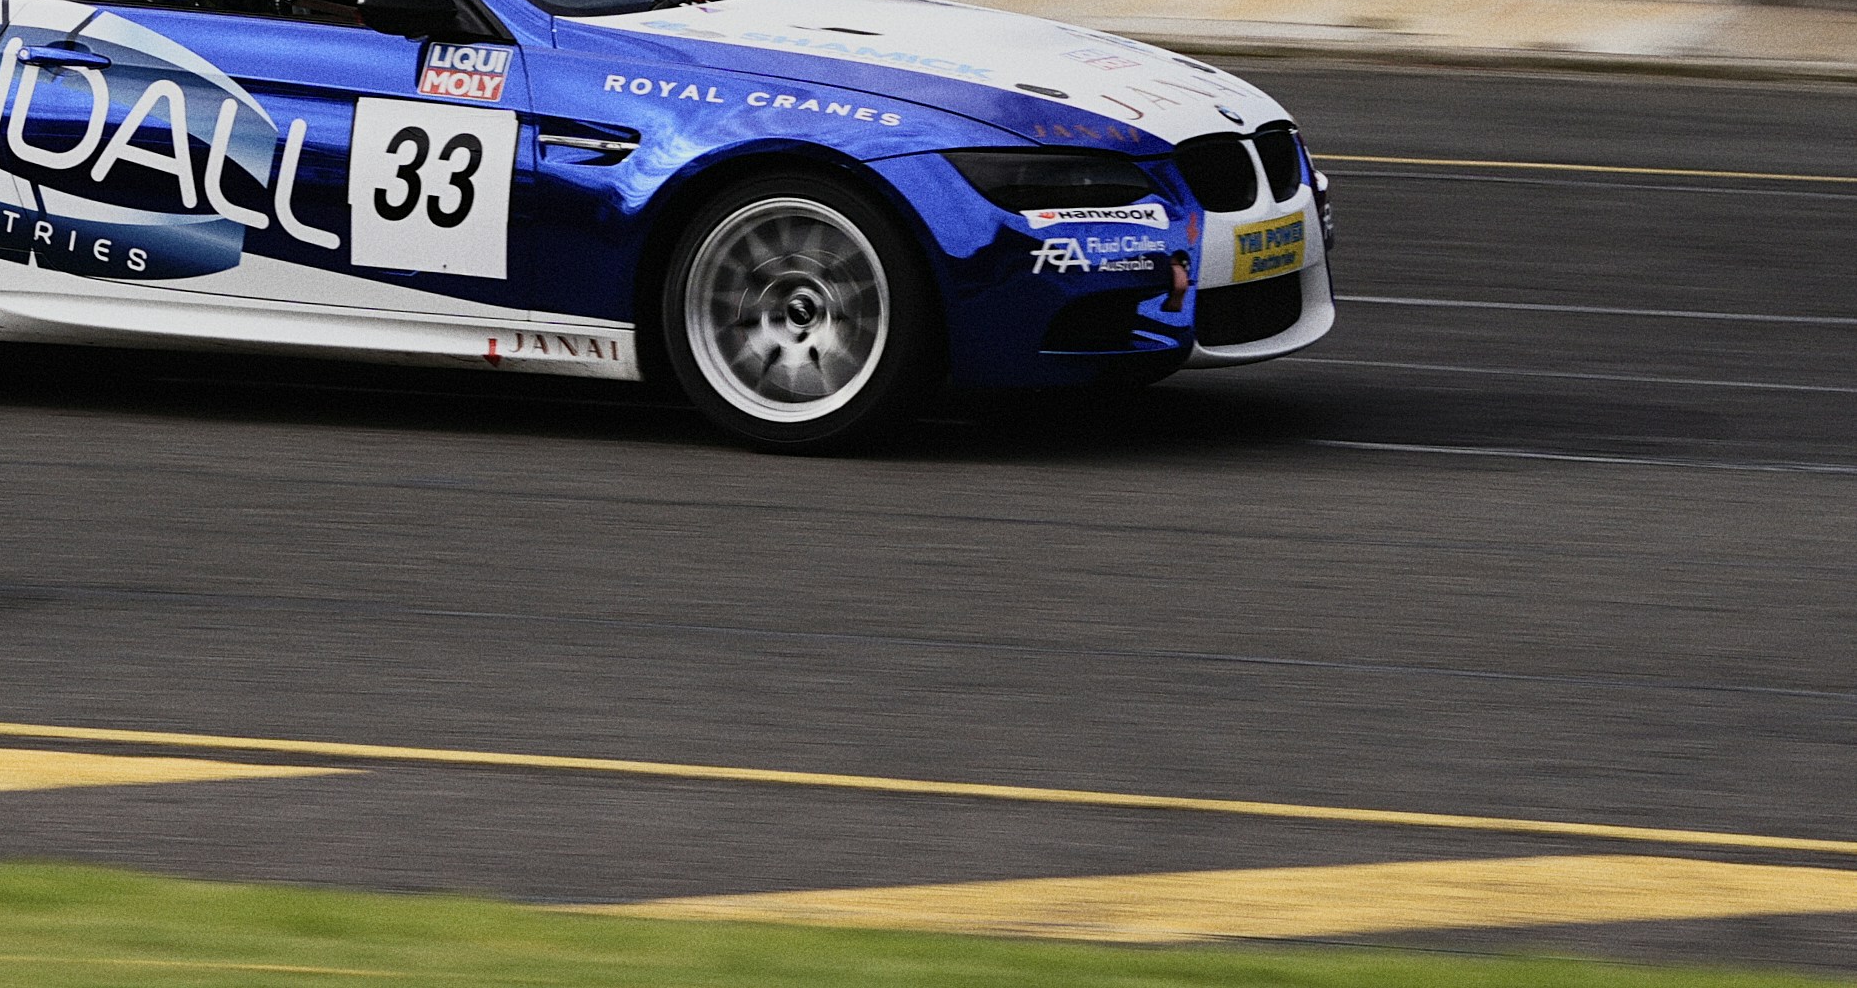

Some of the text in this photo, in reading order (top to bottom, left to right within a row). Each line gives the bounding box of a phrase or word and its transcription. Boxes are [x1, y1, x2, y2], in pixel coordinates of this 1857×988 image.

[429, 44, 509, 73] LIQUI
[421, 70, 503, 98] MOLY
[603, 74, 903, 128] ROYAL CRANES
[373, 125, 484, 229] 33
[1086, 236, 1121, 253] Fluid
[1098, 255, 1155, 272] Australia
[508, 332, 620, 361] JANAI
